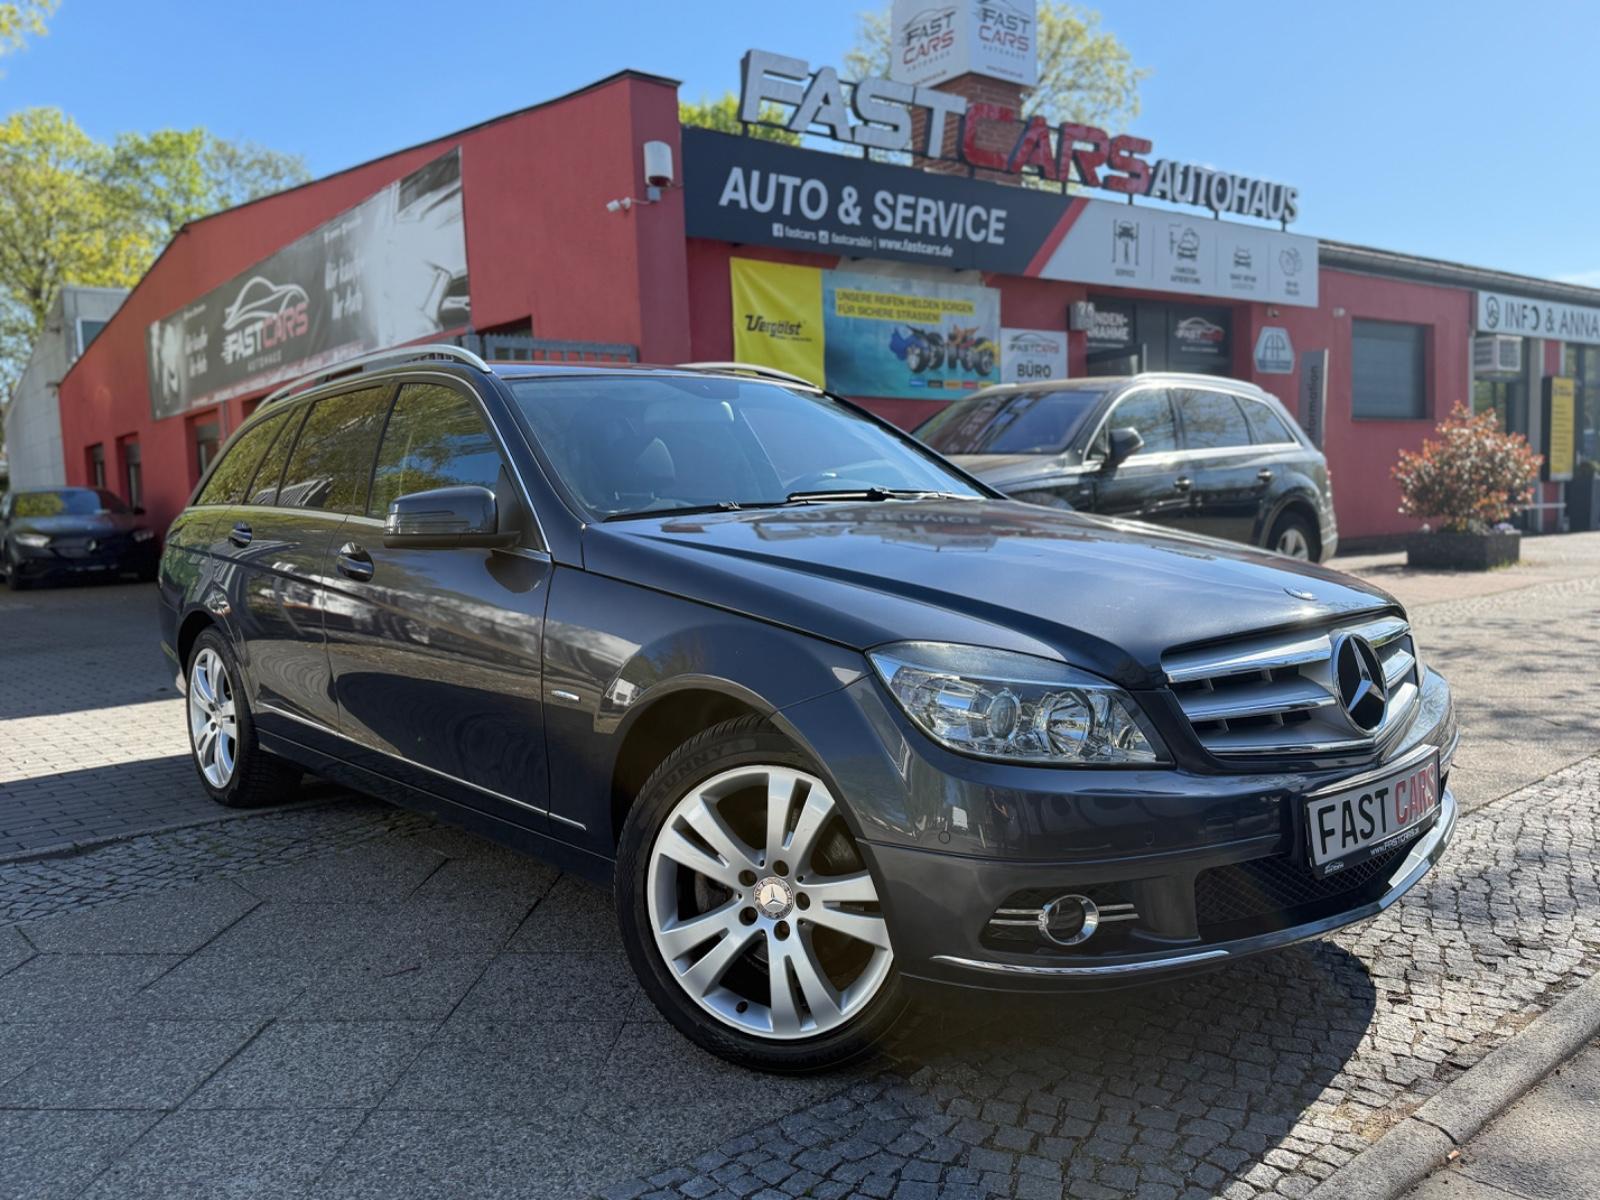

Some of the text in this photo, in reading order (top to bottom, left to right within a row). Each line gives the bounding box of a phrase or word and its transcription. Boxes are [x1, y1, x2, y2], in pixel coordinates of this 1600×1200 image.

[906, 11, 956, 45] FAST
[979, 25, 1029, 51] CARS
[981, 8, 1030, 34] FAST
[903, 30, 954, 64] CARS
[718, 166, 1007, 245] AUTO & SERVICE
[1150, 159, 1298, 223] AUTOHAUS
[744, 314, 803, 337] Vergölst
[1017, 360, 1051, 377] BÜRO
[1317, 764, 1436, 855] FAST CARS
